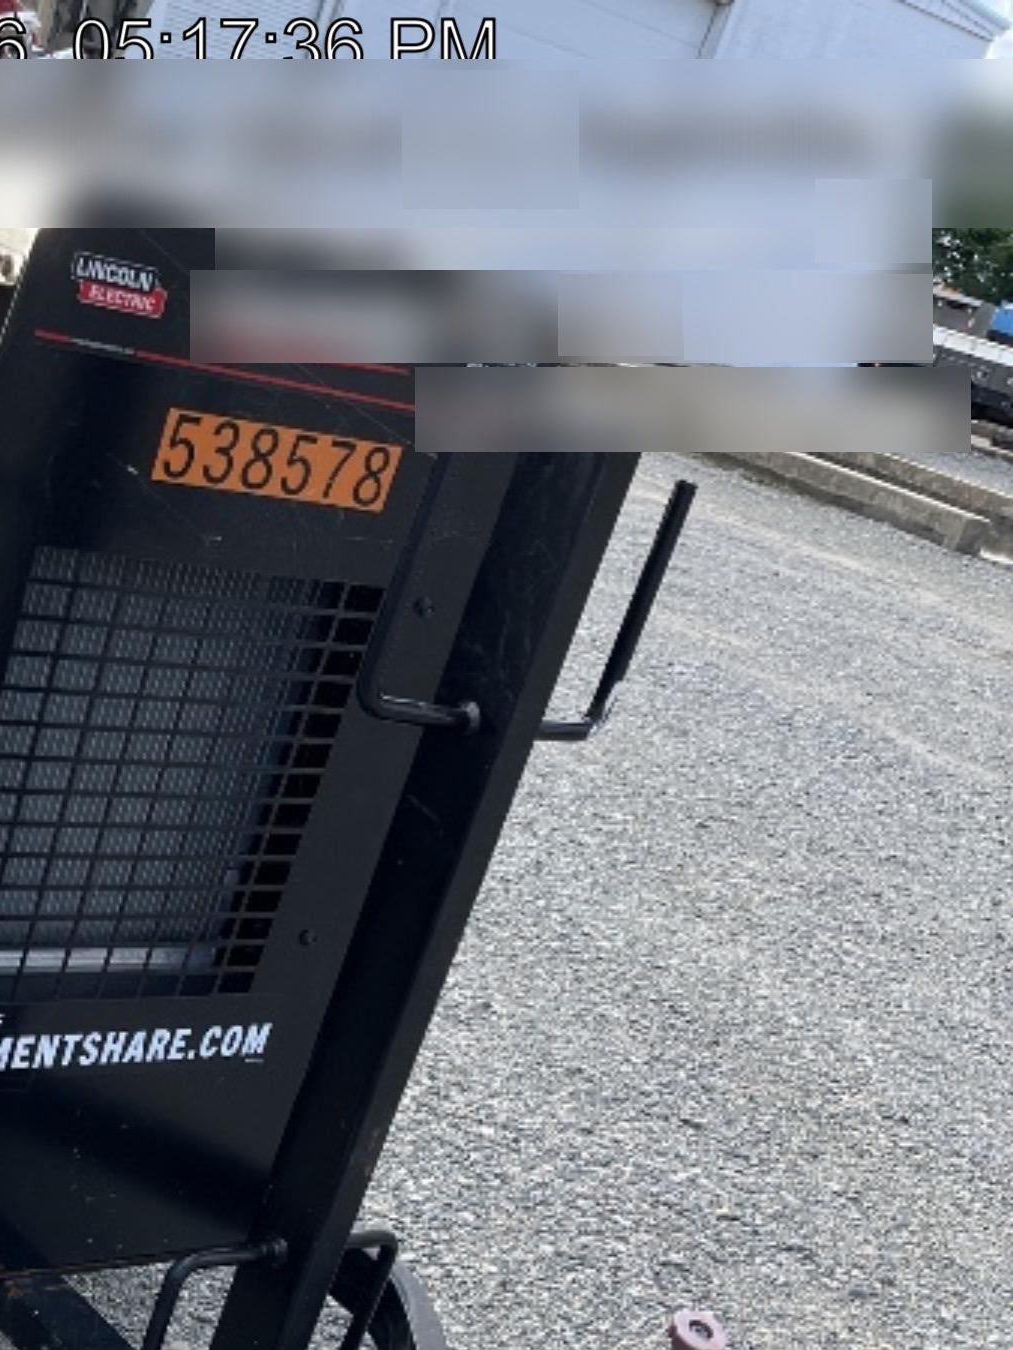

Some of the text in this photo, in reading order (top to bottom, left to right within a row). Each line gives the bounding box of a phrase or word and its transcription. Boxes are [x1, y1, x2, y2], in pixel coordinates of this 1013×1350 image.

[76, 257, 153, 292] LINCOLN
[88, 283, 156, 310] ELECTRIC
[163, 413, 389, 507] 538578
